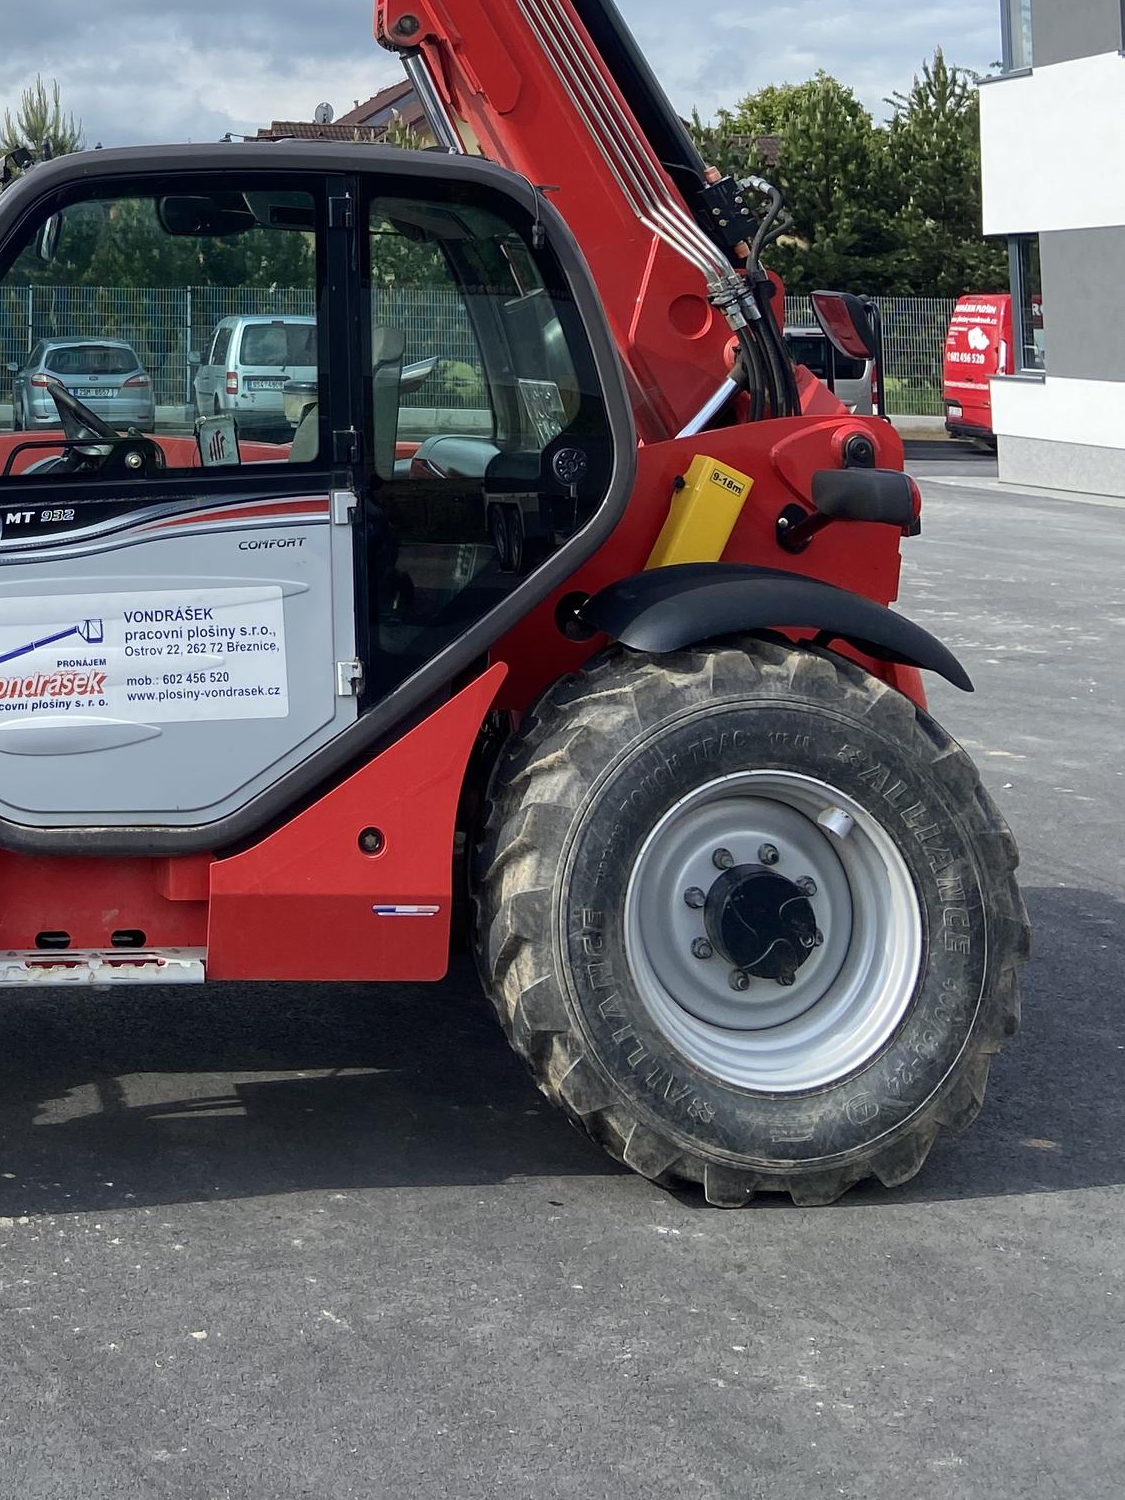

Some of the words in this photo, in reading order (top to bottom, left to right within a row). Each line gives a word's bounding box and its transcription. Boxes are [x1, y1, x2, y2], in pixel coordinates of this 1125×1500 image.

[712, 472, 742, 494] 9-18m
[5, 511, 35, 525] MT
[40, 509, 75, 523] 932
[238, 537, 307, 551] COMFORT
[124, 606, 214, 624] VONDRÁŠEK
[125, 627, 183, 643] pracovní
[187, 625, 235, 641] plošiny
[125, 645, 164, 658] Ostrov
[167, 644, 184, 657] 22,
[187, 643, 207, 655] 262
[210, 643, 224, 654] 72
[227, 640, 280, 653] Březnice,
[56, 657, 107, 669] PRONÁJEM
[163, 673, 182, 686] 602
[184, 672, 207, 685] 456
[209, 671, 229, 684] 520
[127, 685, 281, 702] www.plosiny-vondrasek.cz
[31, 698, 71, 712] plošiny
[75, 700, 85, 708] s.
[98, 698, 108, 707] o.
[857, 762, 971, 955] ALLIANCE
[582, 907, 693, 1103] ALLIANCE
